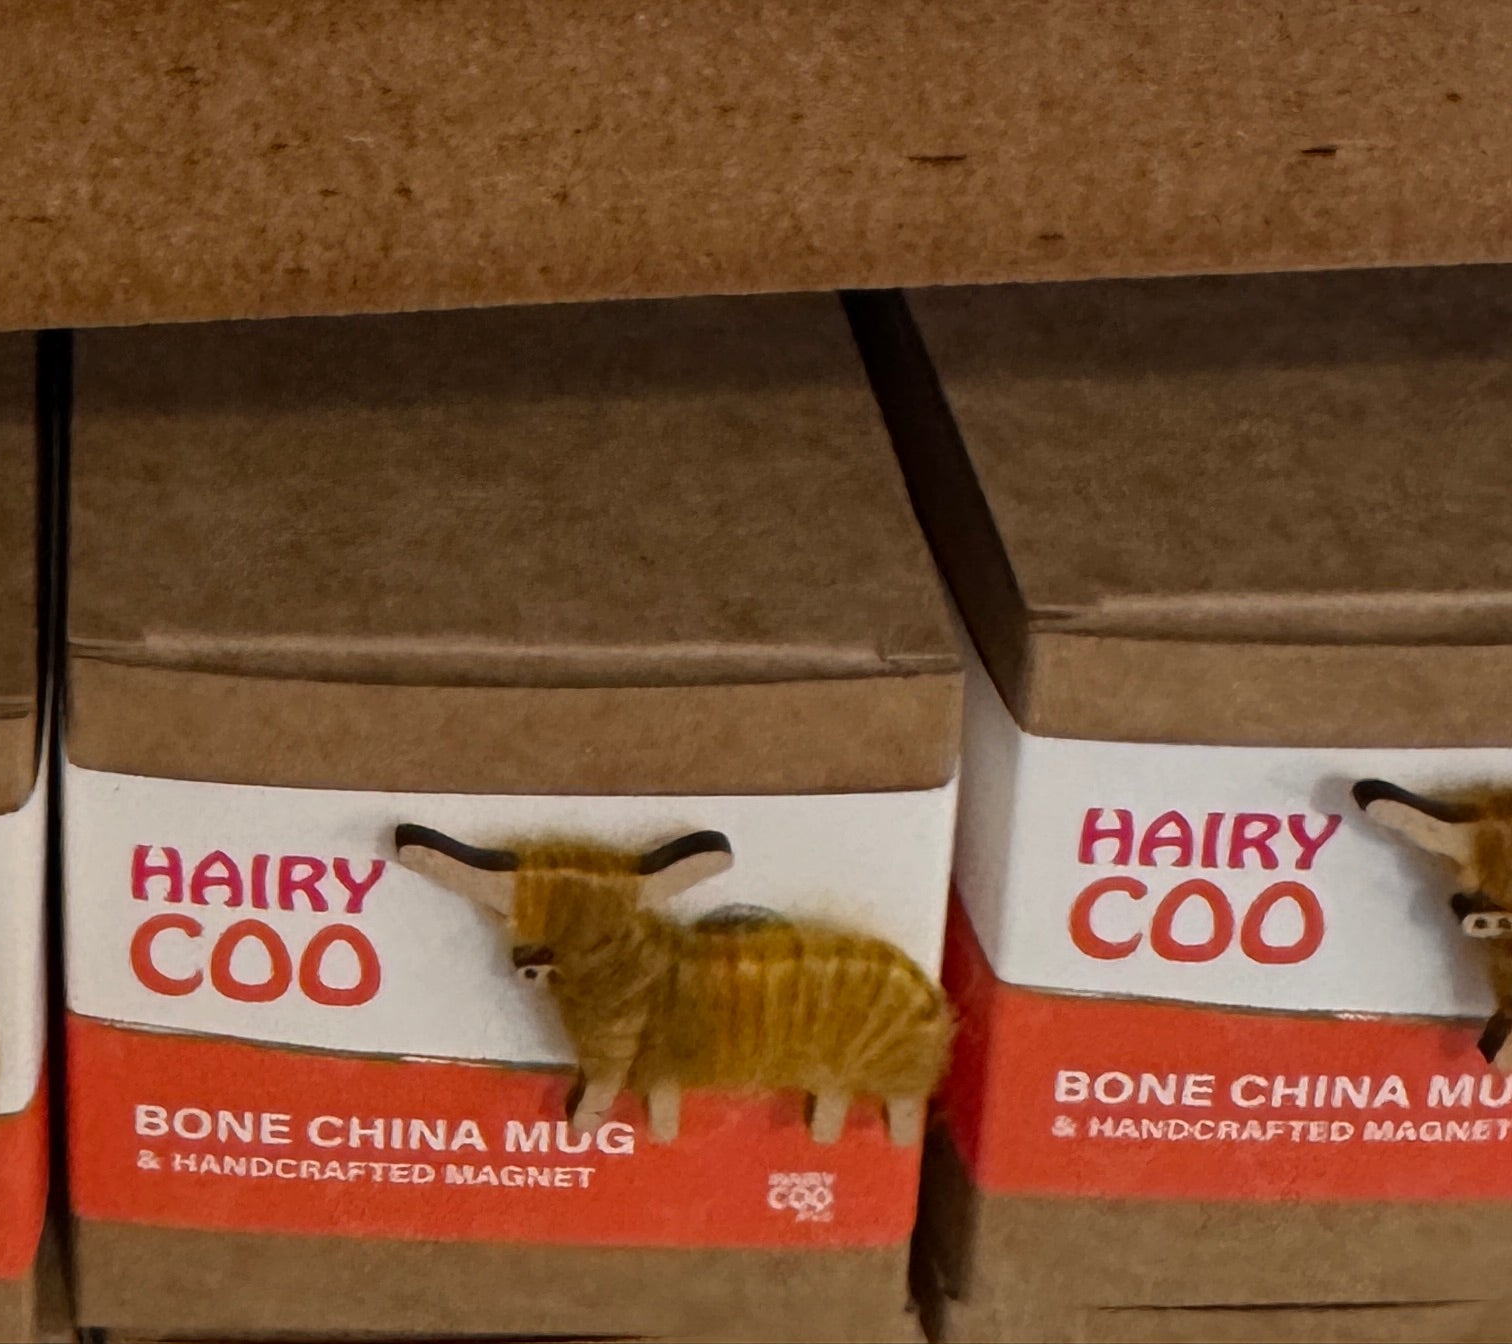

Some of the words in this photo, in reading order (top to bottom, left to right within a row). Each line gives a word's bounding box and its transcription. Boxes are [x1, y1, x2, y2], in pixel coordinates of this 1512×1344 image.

[1077, 808, 1343, 870] HAIRY
[131, 844, 386, 913] HAIRY
[1068, 876, 1325, 965] COO
[129, 914, 382, 1007] COO
[1053, 1070, 1216, 1108] BONE
[1230, 1074, 1410, 1109] CHINA
[133, 1104, 293, 1146] BONE
[306, 1115, 489, 1152] CHINA
[503, 1120, 635, 1155] MUG
[1088, 1116, 1355, 1143] HANDCRAFTED
[136, 1150, 160, 1171] &
[173, 1152, 437, 1185] HANDCRAFTED
[444, 1163, 597, 1190] MAGNET
